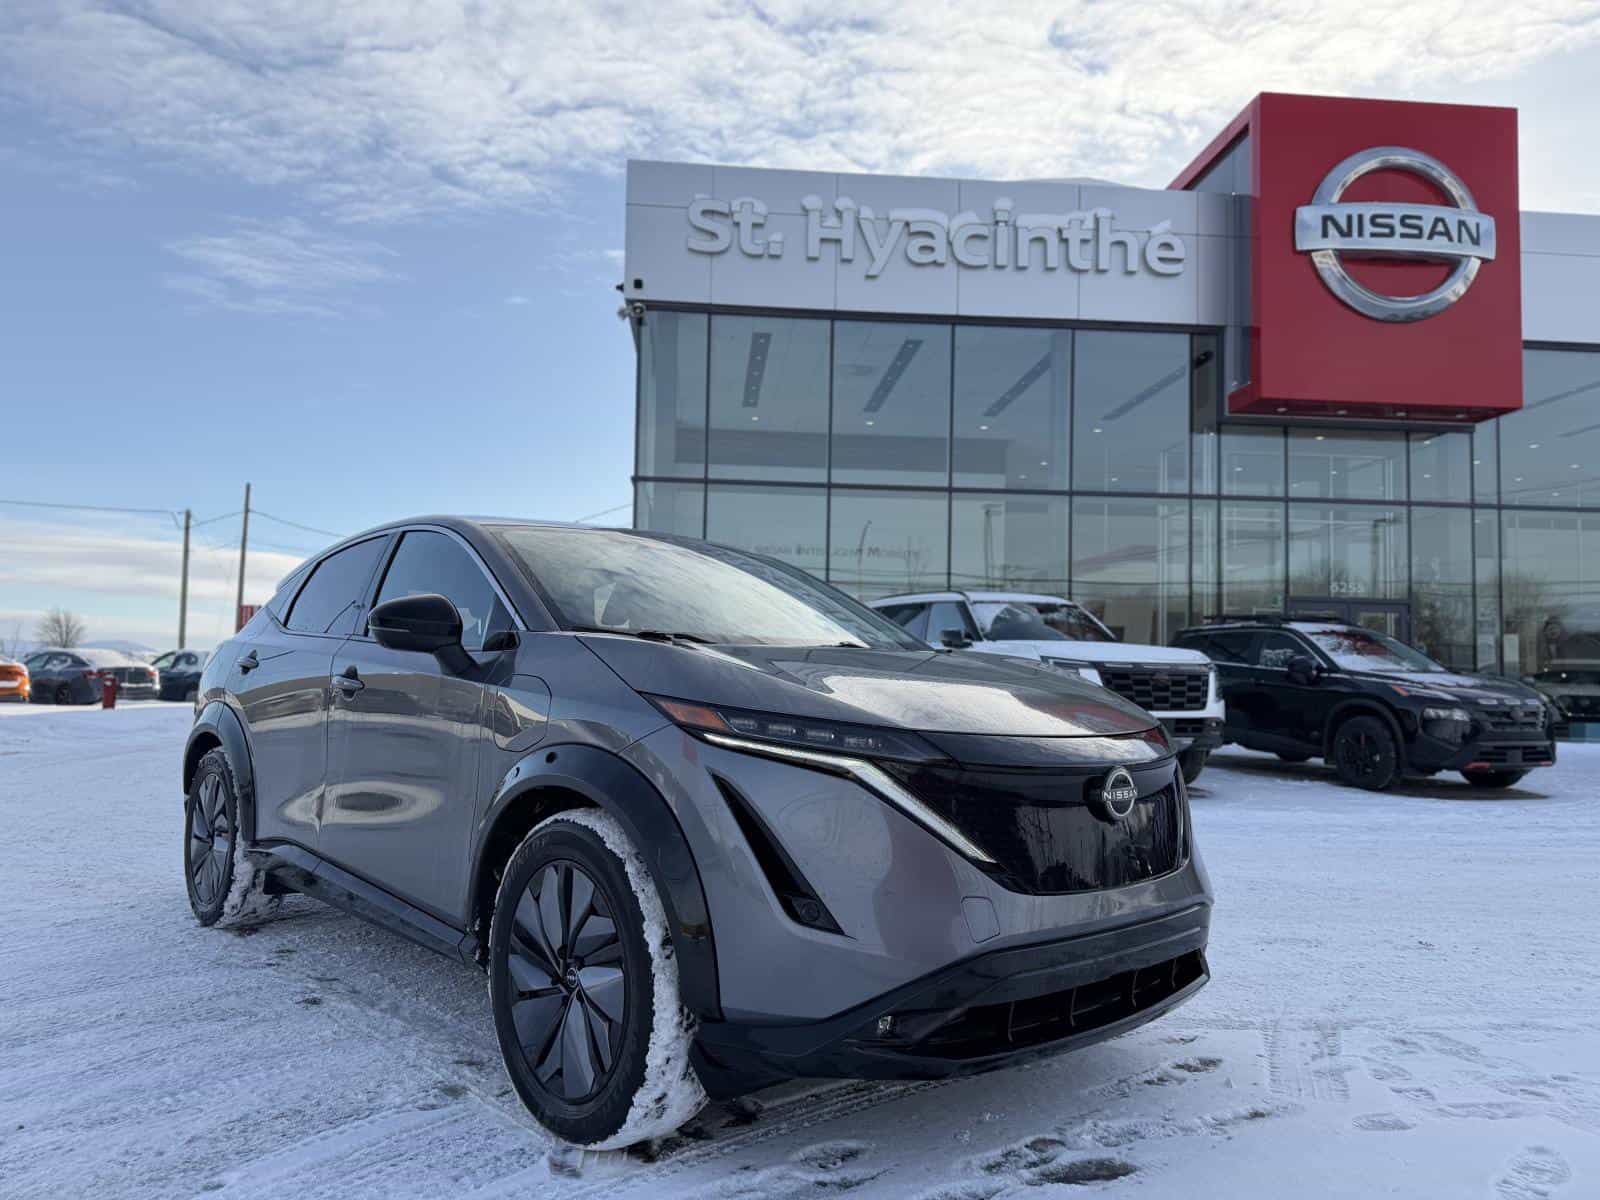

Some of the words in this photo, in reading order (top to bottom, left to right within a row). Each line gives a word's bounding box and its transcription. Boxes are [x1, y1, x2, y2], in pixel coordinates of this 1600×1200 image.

[688, 199, 784, 257] St.
[1321, 213, 1480, 246] NISSAN
[1103, 789, 1137, 800] NISSAN
